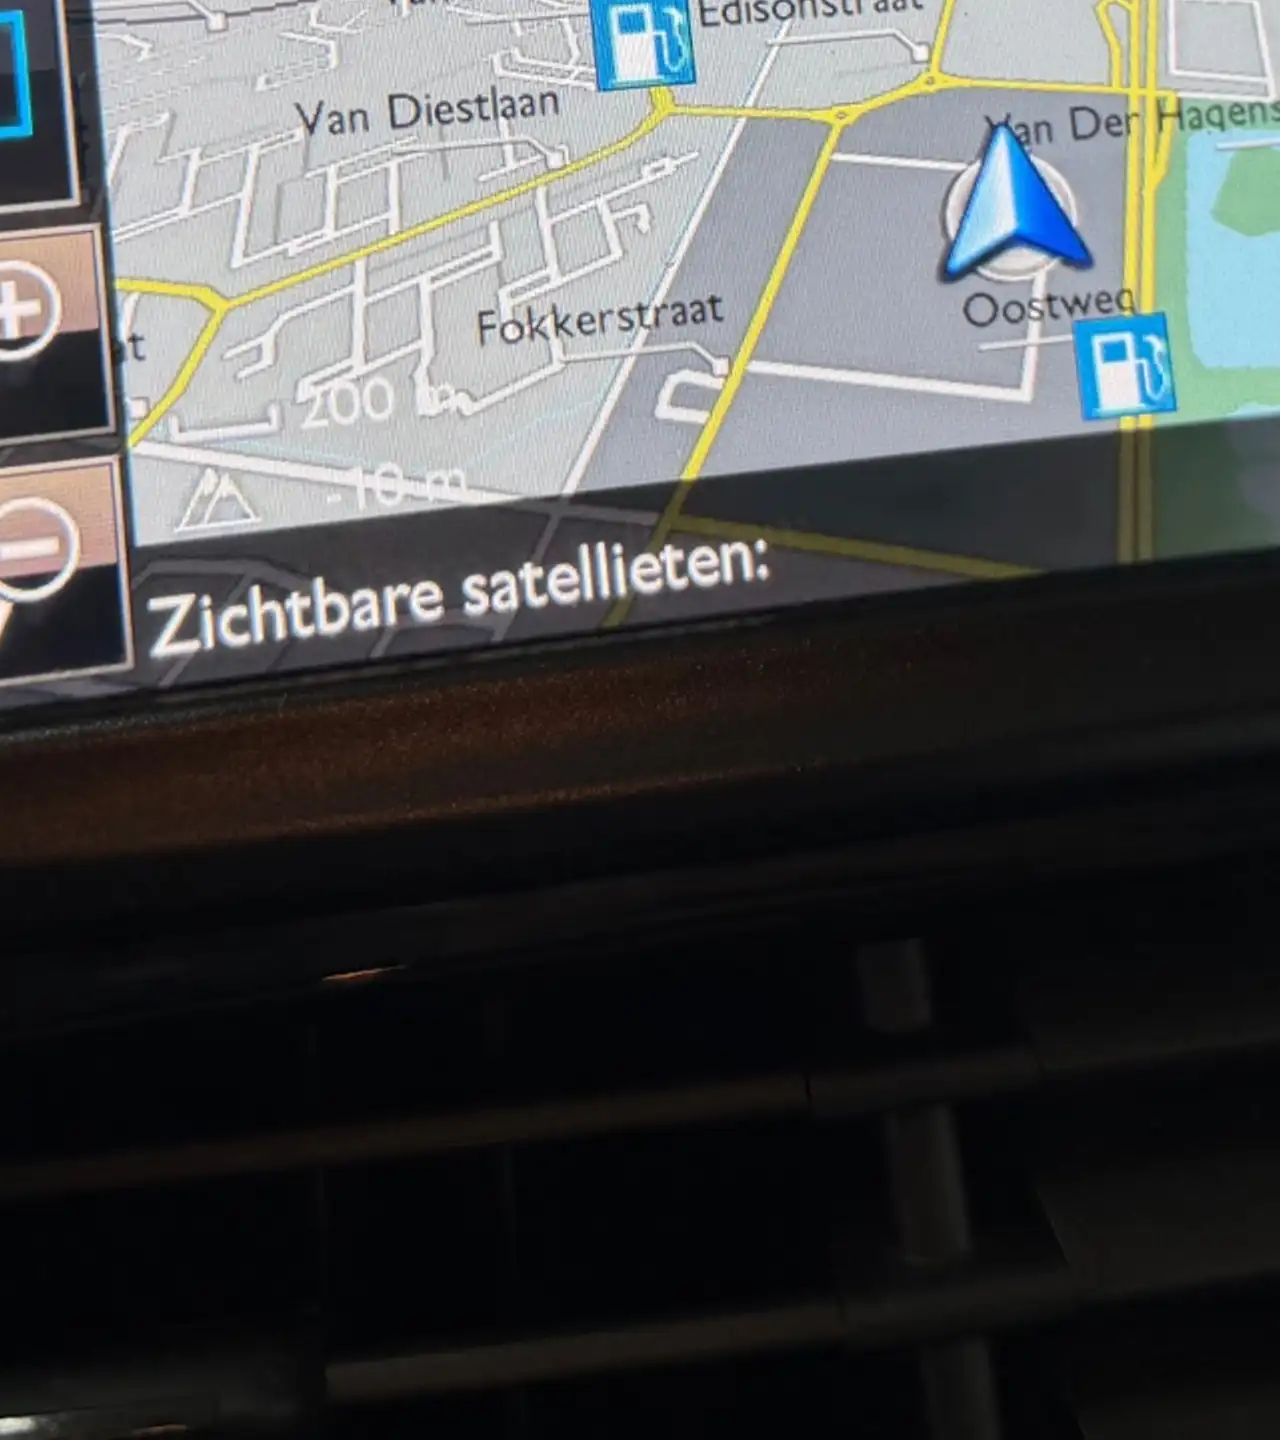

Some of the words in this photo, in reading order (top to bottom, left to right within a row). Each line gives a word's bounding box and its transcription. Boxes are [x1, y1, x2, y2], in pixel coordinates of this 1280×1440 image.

[295, 98, 369, 136] Van
[389, 85, 559, 129] Diestlaan
[1070, 106, 1138, 141] Der
[478, 294, 723, 346] Fokkerstraat
[301, 376, 395, 430] 200
[147, 577, 444, 660] Zichtbare
[462, 539, 770, 616] satellieten:
